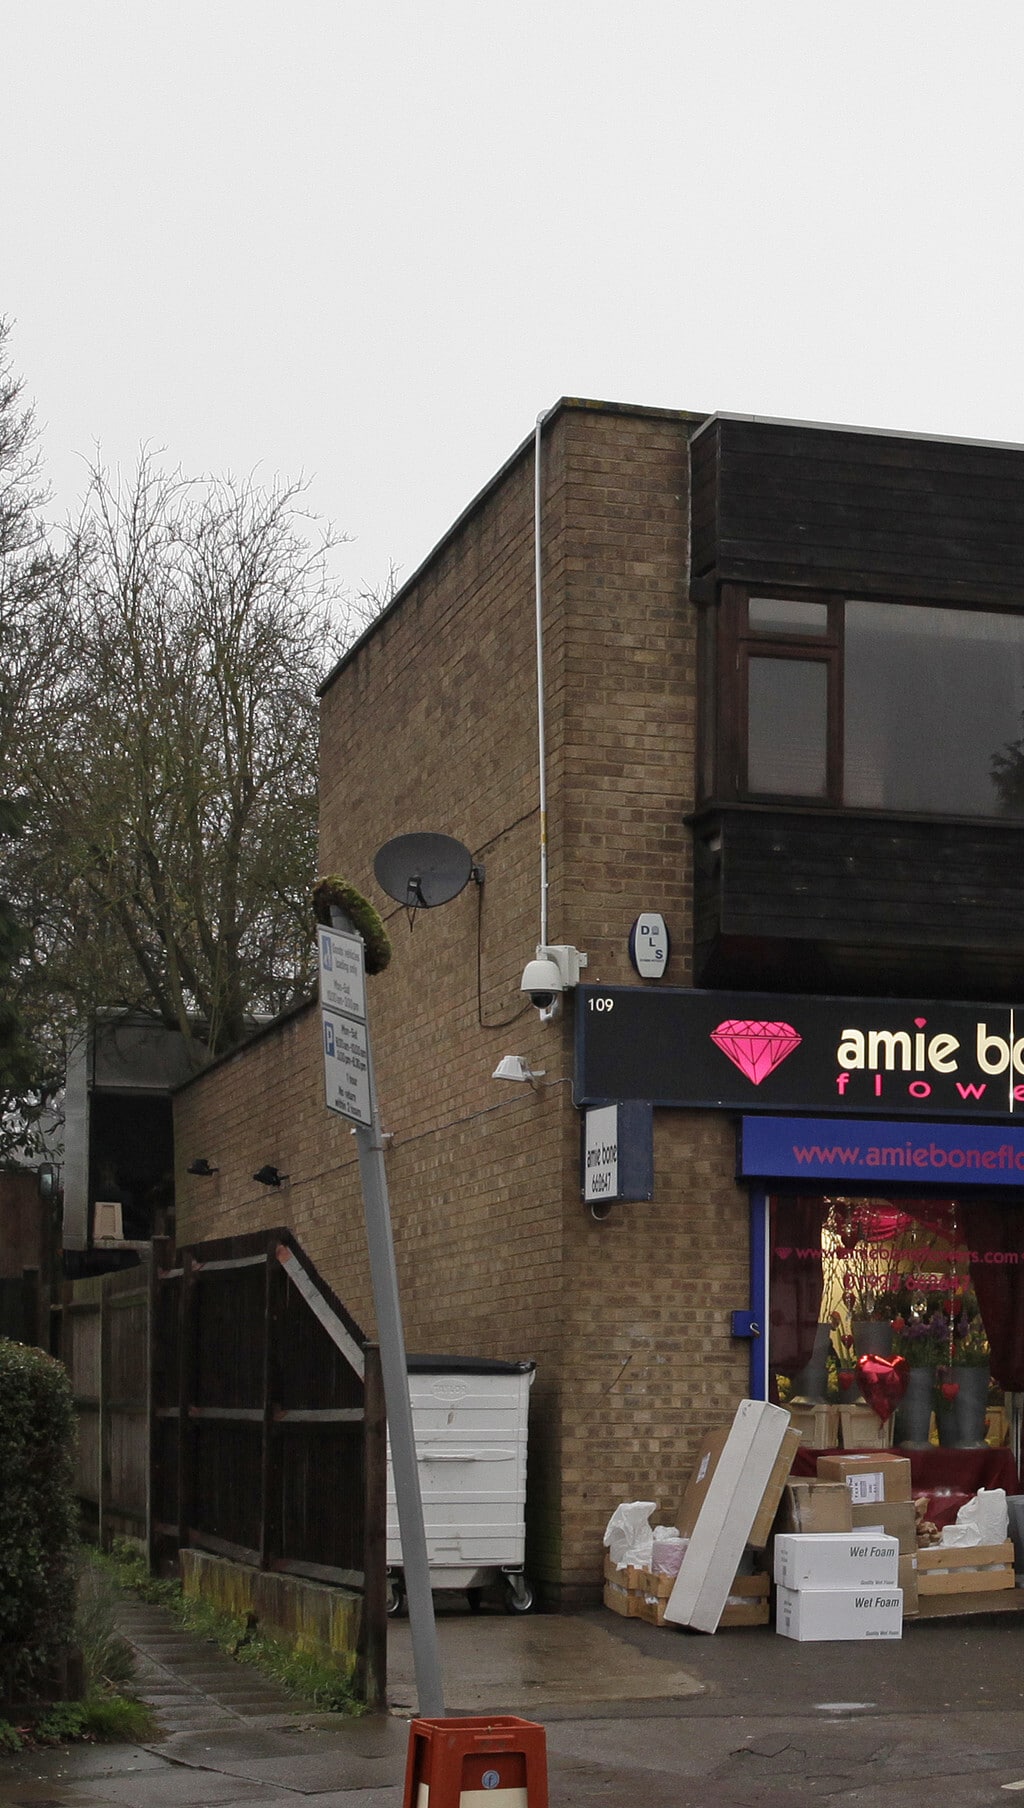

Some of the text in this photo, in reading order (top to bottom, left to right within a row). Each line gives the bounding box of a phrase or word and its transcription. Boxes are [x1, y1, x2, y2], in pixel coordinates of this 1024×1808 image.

[588, 998, 614, 1012] 109
[837, 1017, 958, 1074] amie
[587, 1141, 618, 1168] amie bone
[850, 1546, 895, 1558] Wet Foam
[855, 1597, 900, 1608] Wet Foam
